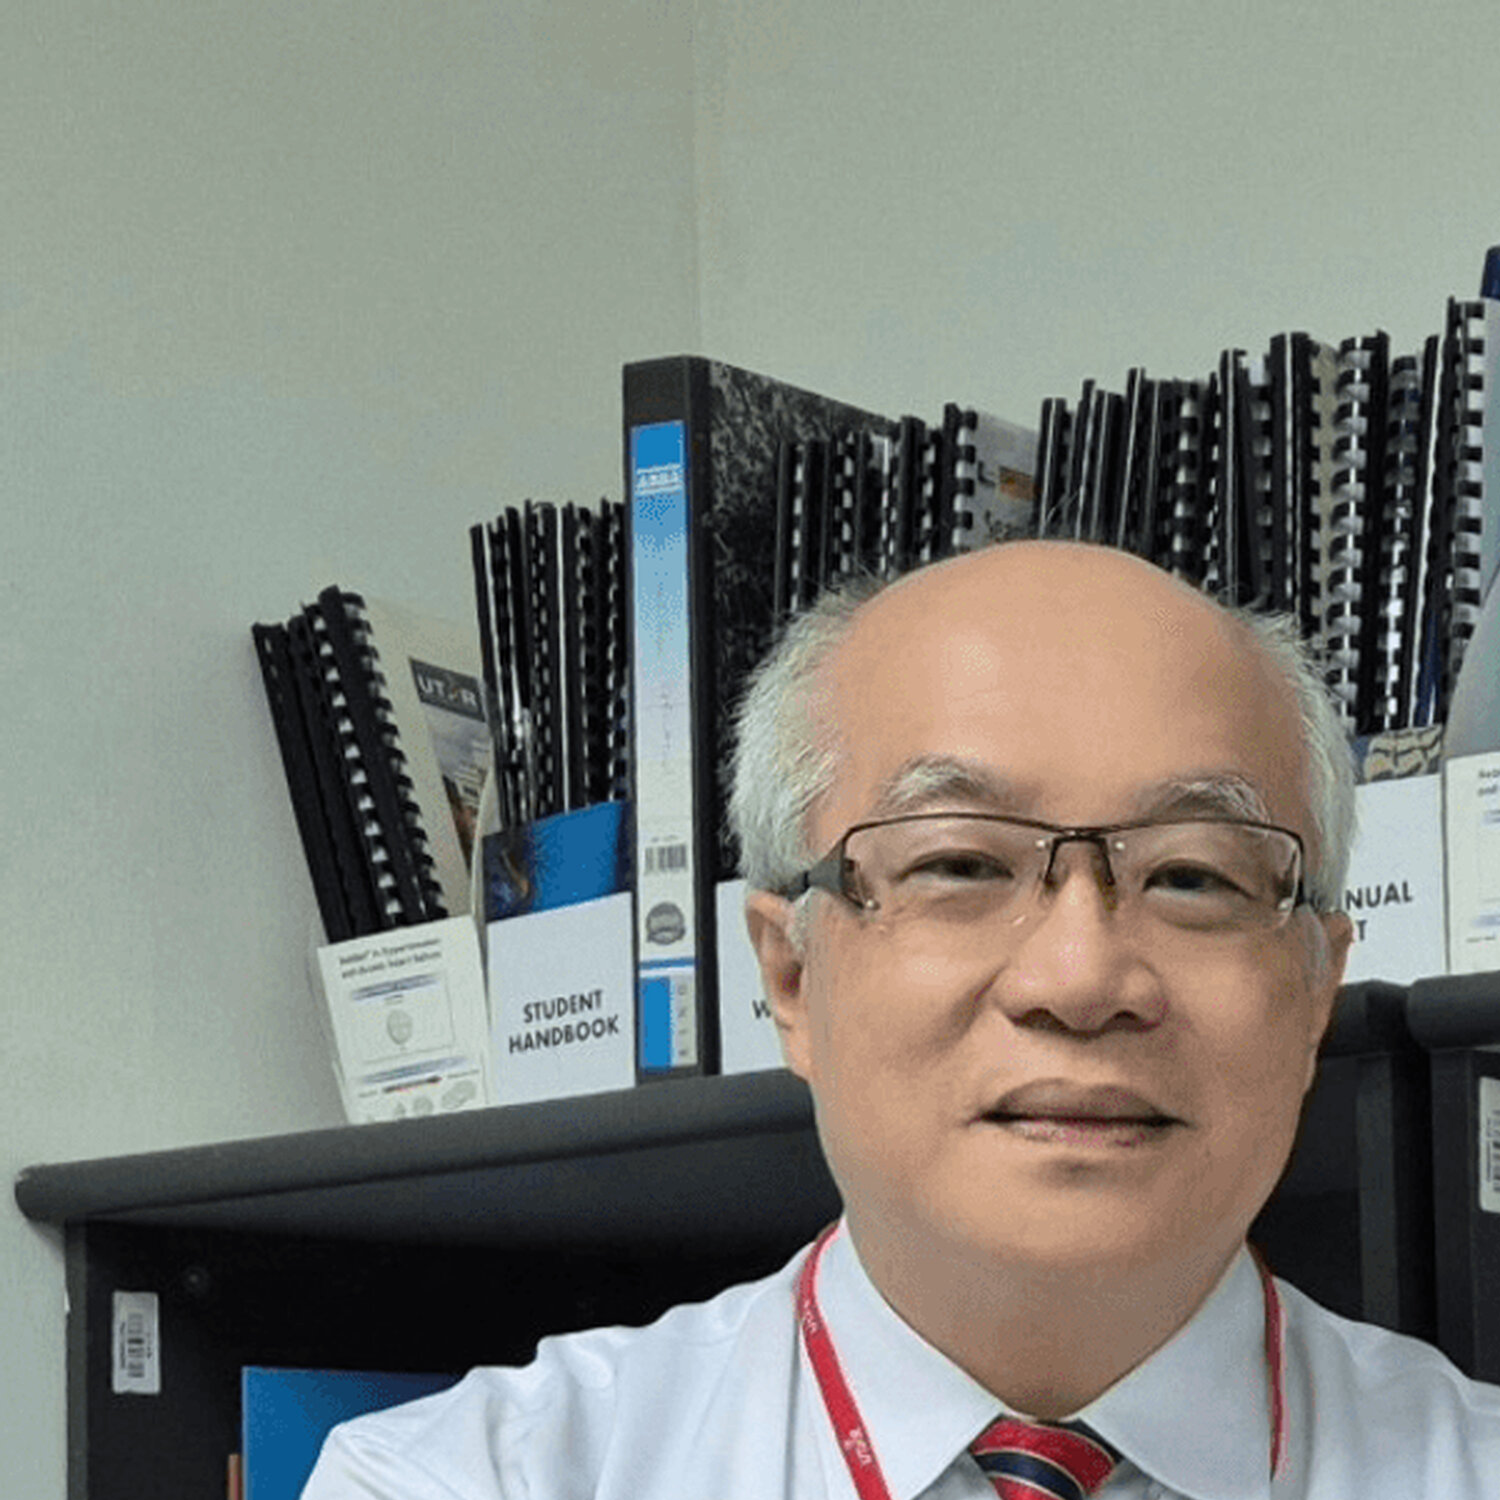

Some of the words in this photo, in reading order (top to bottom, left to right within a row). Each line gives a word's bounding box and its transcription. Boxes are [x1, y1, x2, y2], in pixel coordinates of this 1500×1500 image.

[1346, 881, 1413, 911] NUAL
[523, 989, 602, 1023] STUDENT
[509, 1014, 619, 1054] HANDBOOK
